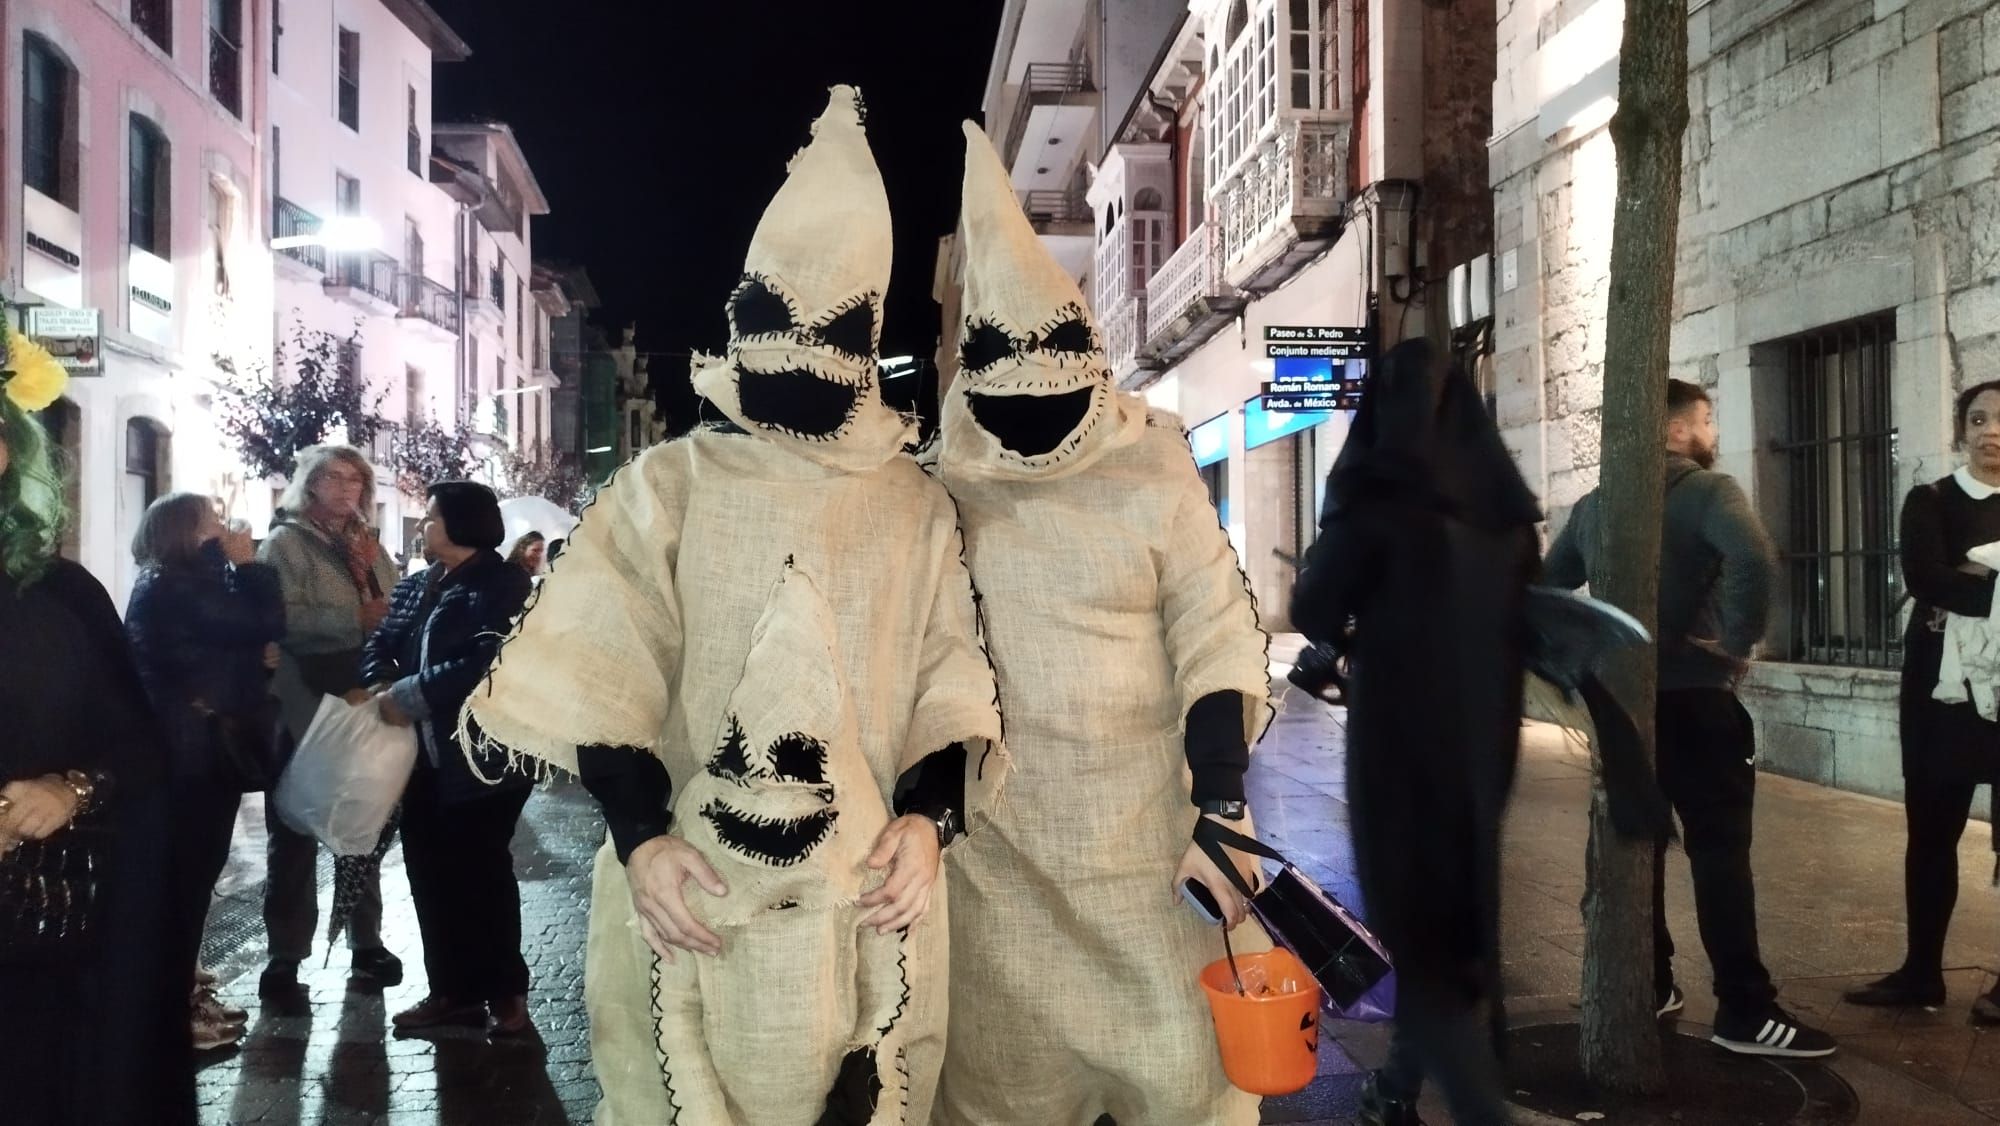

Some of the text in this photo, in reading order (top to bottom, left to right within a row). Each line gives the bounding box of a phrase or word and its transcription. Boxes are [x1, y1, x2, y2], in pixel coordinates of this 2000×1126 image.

[1270, 328, 1344, 338] Paseo de S. Pedro
[1269, 346, 1349, 357] Conjunto medieval
[1270, 382, 1341, 393] Román Romano
[1267, 399, 1292, 408] Avda.
[1303, 398, 1337, 408] México
